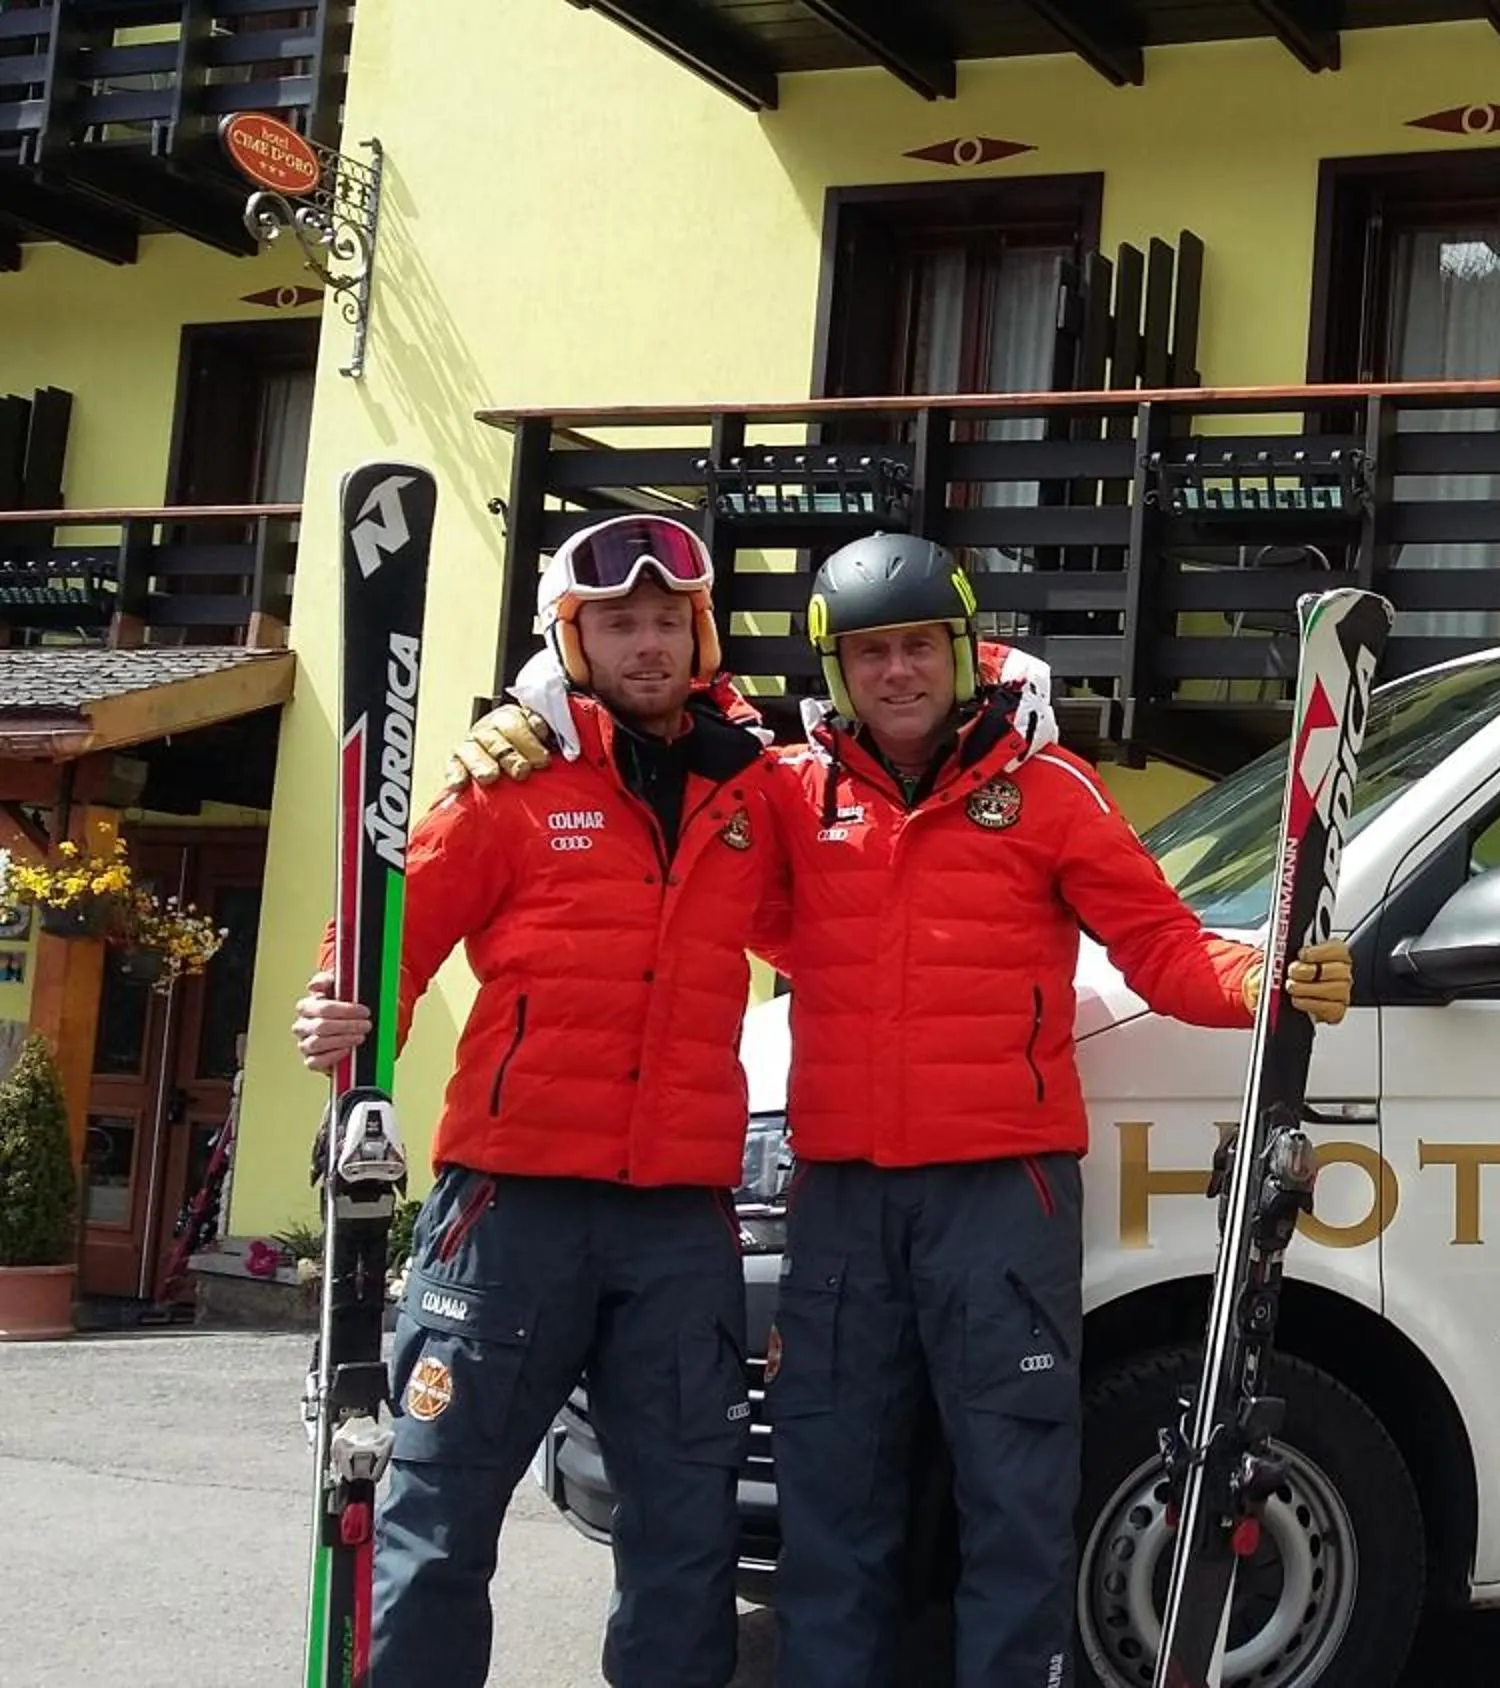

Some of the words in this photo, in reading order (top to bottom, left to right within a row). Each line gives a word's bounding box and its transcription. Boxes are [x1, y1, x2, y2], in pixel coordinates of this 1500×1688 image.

[233, 129, 270, 157] CIME
[271, 145, 313, 176] D'ORO
[364, 632, 420, 870] NORDICA
[548, 811, 605, 829] COLMAR
[1271, 836, 1298, 990] DOBERMANN
[422, 1291, 467, 1320] COLMAR
